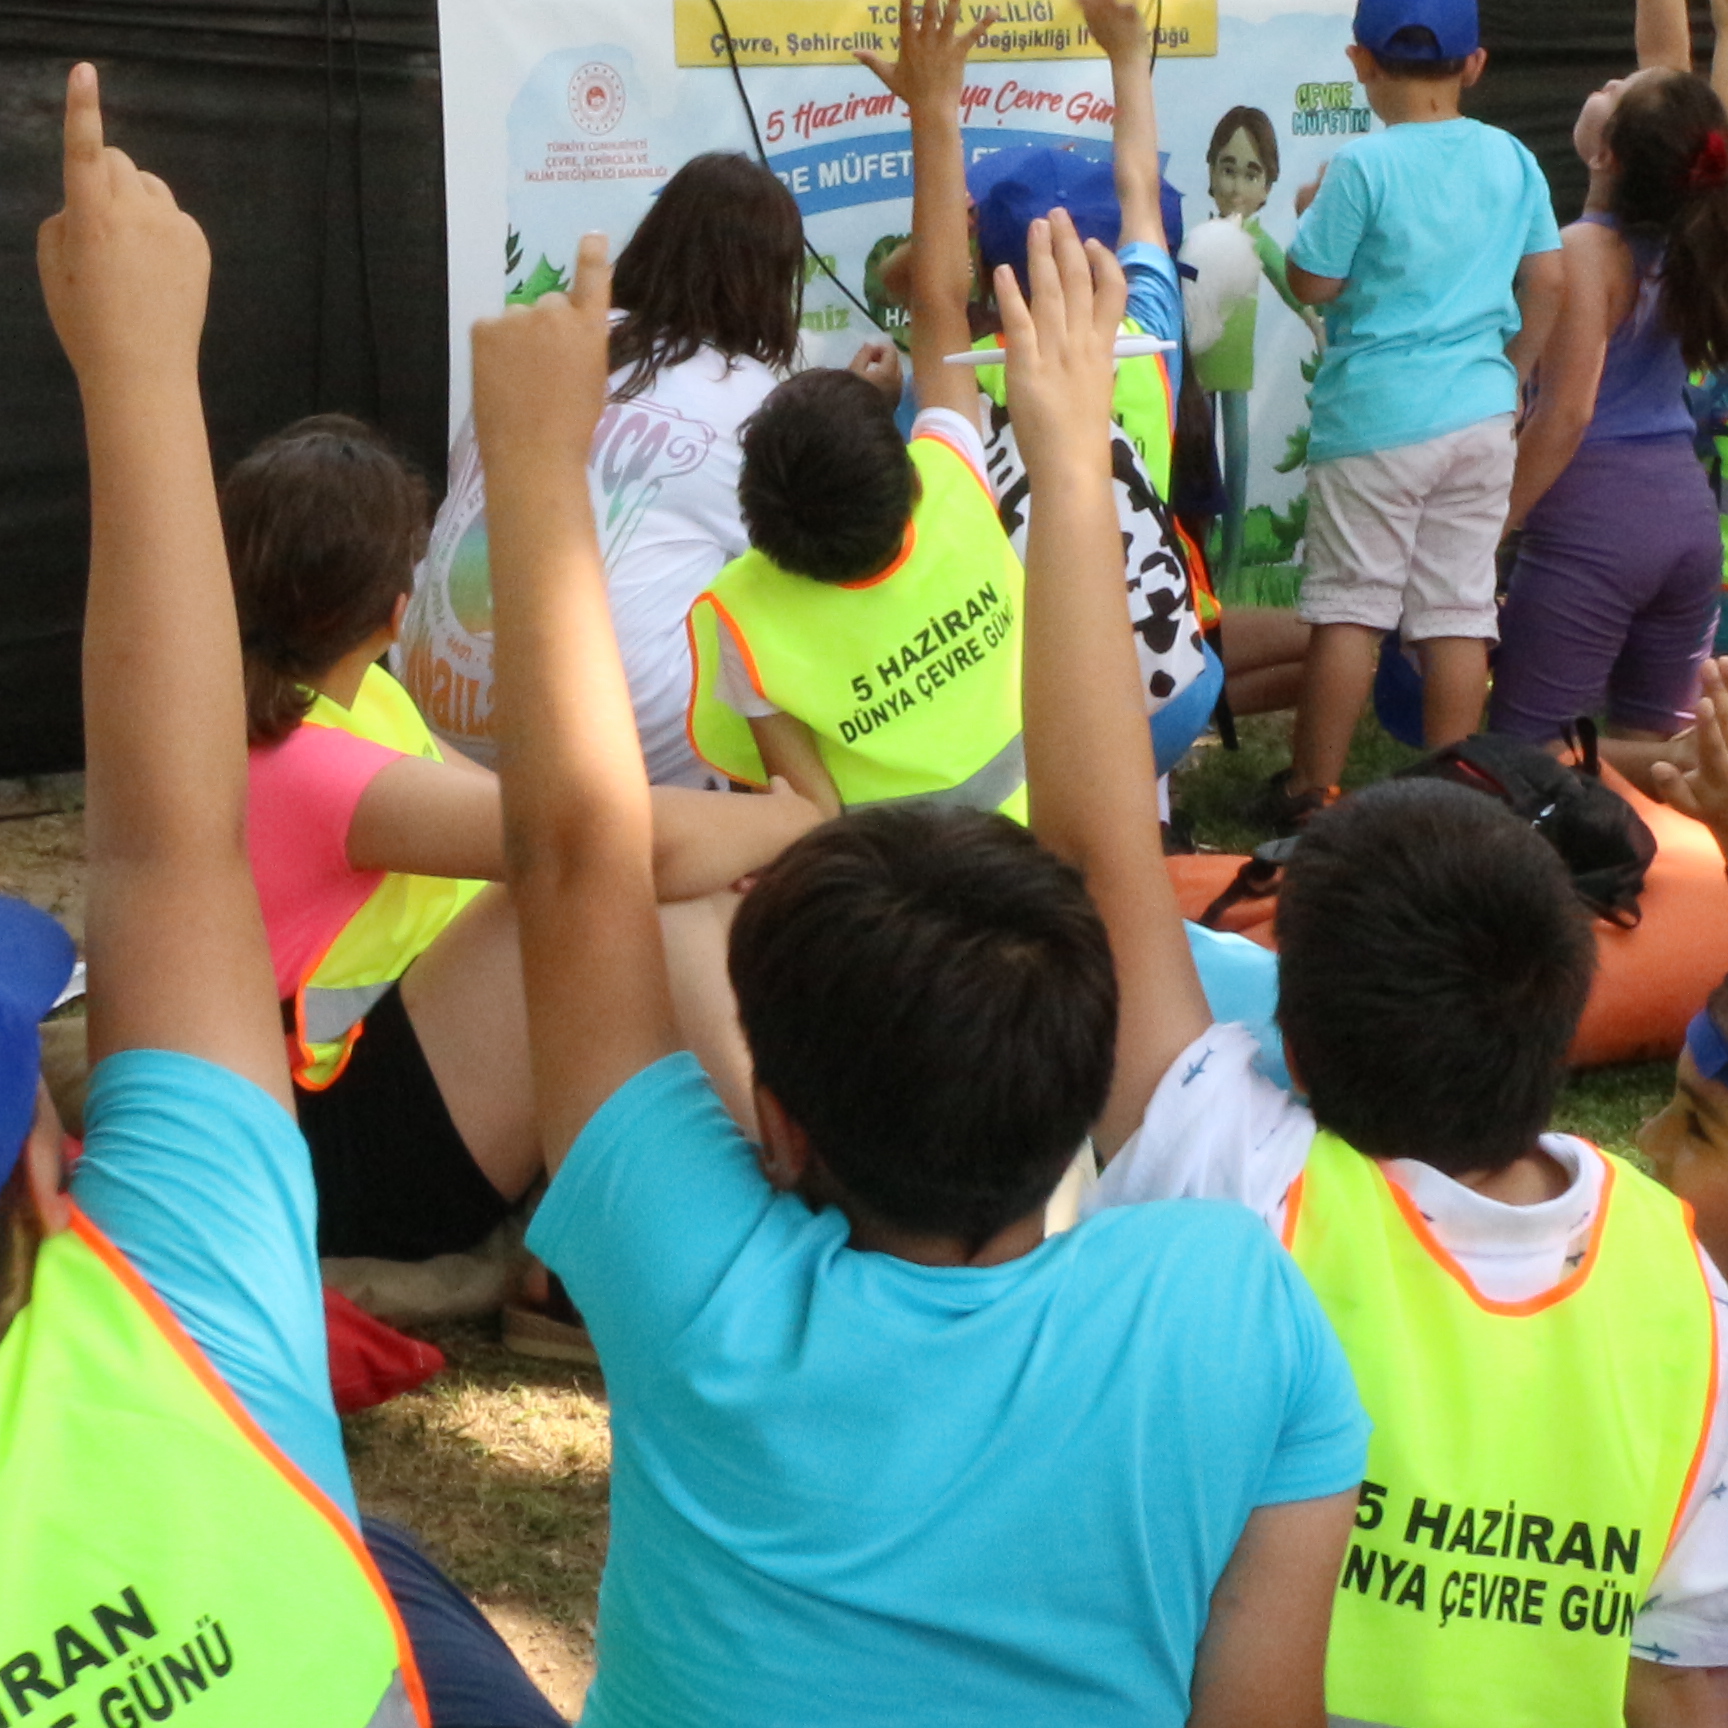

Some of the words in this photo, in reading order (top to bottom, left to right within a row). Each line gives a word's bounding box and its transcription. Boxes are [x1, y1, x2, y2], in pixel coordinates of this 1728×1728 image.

[786, 32, 884, 57] Şehircilik
[766, 110, 785, 143] 5
[793, 91, 896, 139] Haziran
[994, 80, 1063, 126] Çevre
[1064, 91, 1123, 126] Gün
[850, 674, 873, 702] 5
[876, 581, 999, 687] HAZİRAN
[837, 687, 917, 744] DÜNYA
[915, 637, 986, 702] ÇEVRE
[1354, 1479, 1388, 1531] 5
[1403, 1496, 1642, 1575] HAZİRAN
[1340, 1544, 1426, 1612] NYA
[1438, 1570, 1548, 1629] ÇEVRE
[1559, 1578, 1639, 1639] GÜN
[98, 1613, 236, 1728] GÜNÜ
